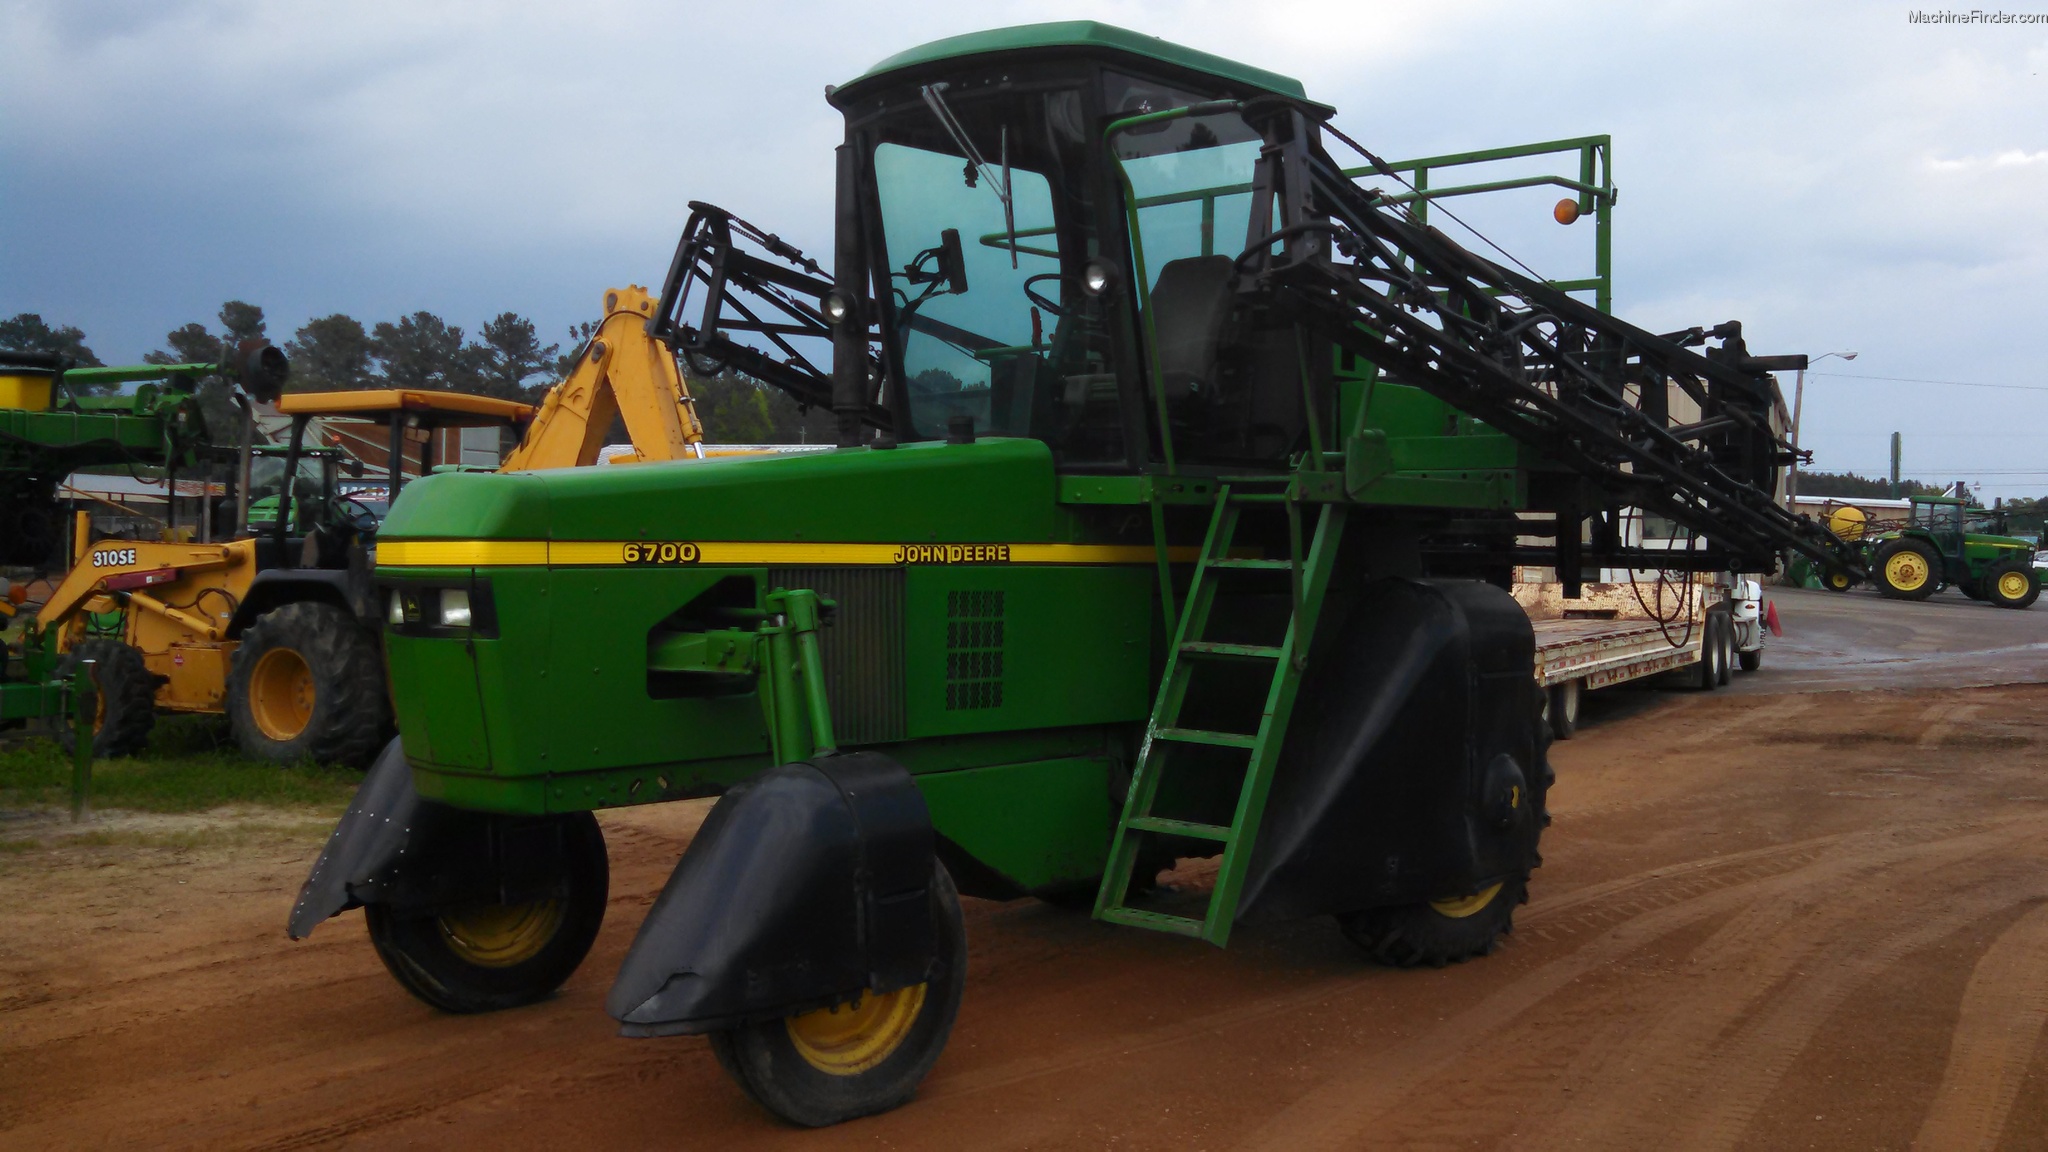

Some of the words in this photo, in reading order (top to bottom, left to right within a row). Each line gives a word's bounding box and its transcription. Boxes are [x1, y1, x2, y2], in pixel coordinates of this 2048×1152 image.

[93, 549, 136, 567] 310SE
[623, 542, 700, 563] 6700
[894, 545, 946, 563] JOHN
[951, 544, 1009, 563] DEERE
